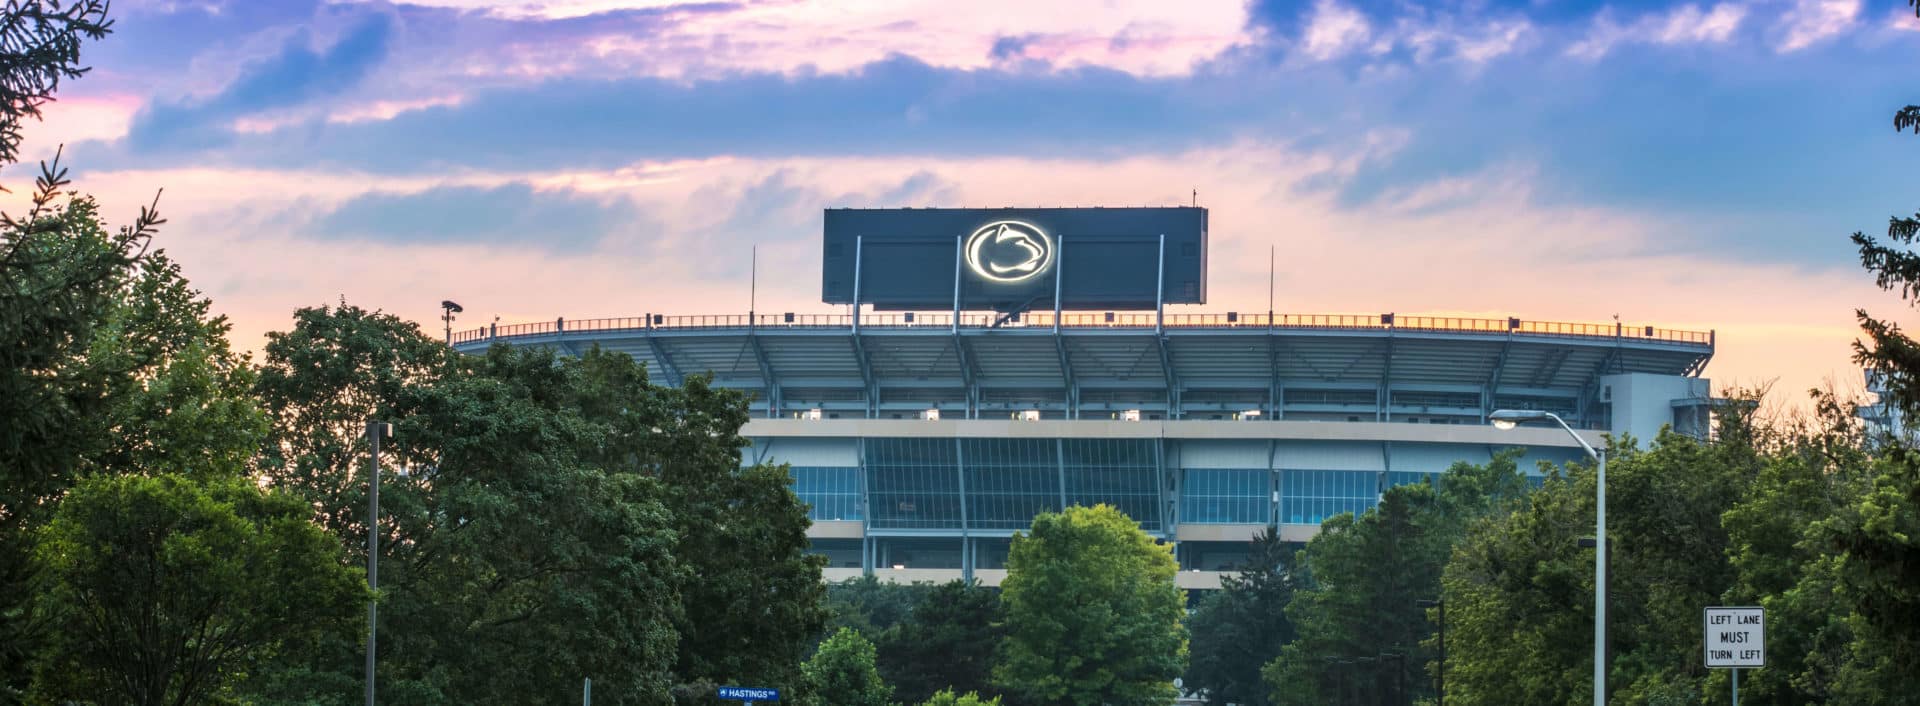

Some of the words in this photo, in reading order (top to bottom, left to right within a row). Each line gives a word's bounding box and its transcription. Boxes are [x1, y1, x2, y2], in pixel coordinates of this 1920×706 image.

[1710, 615, 1732, 624] LEFT
[1738, 615, 1760, 624] LANE
[1720, 632, 1749, 644] MUST
[1710, 650, 1732, 660] TURN
[1740, 650, 1760, 660] LEFT
[728, 689, 768, 698] HASTINGS
